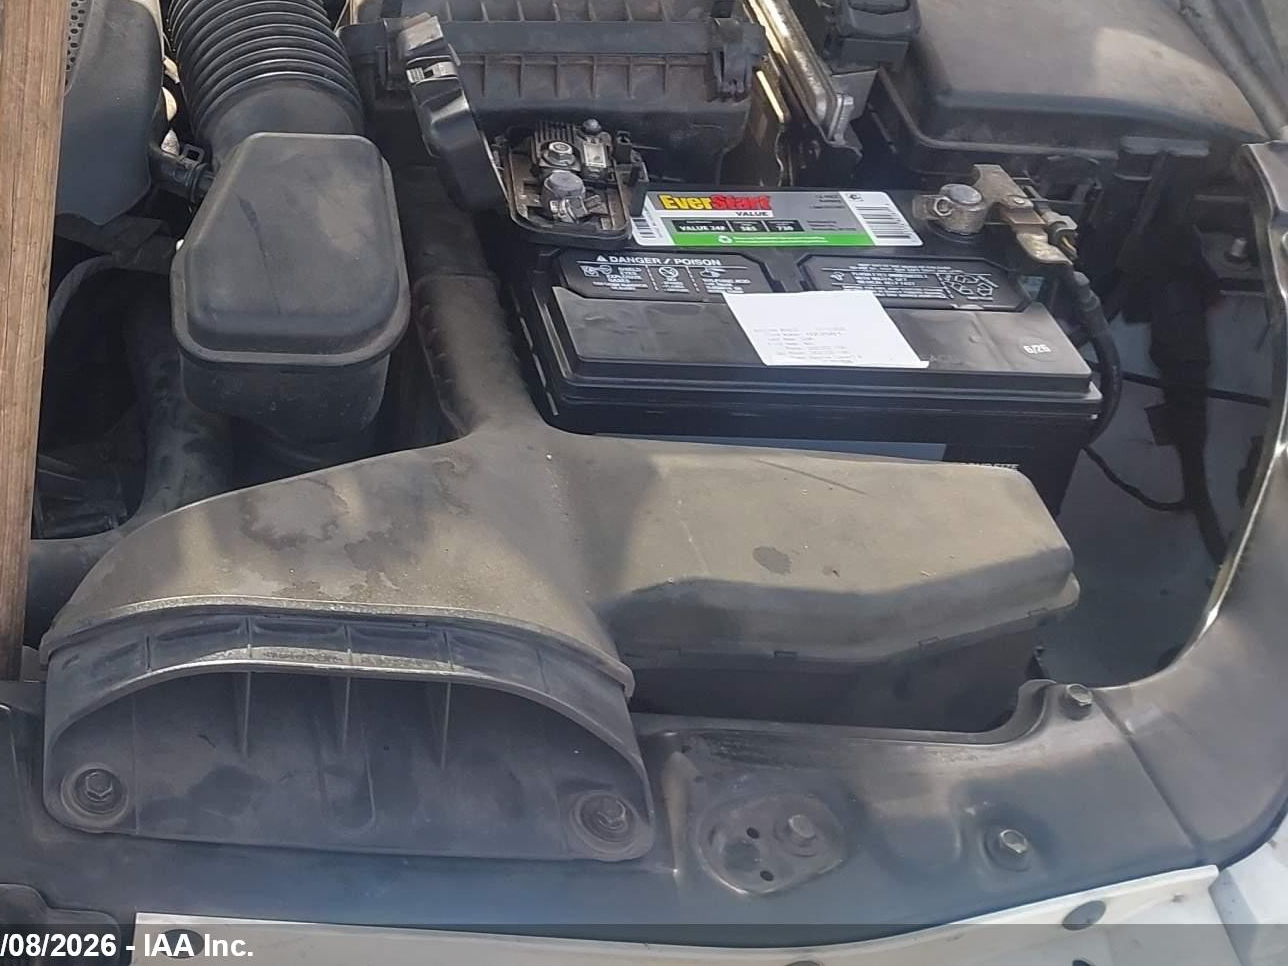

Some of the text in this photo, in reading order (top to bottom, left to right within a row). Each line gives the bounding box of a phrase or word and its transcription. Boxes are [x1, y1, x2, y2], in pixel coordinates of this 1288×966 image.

[658, 194, 772, 211] EverStart
[609, 256, 661, 265] DANGER
[674, 258, 721, 266] POISON
